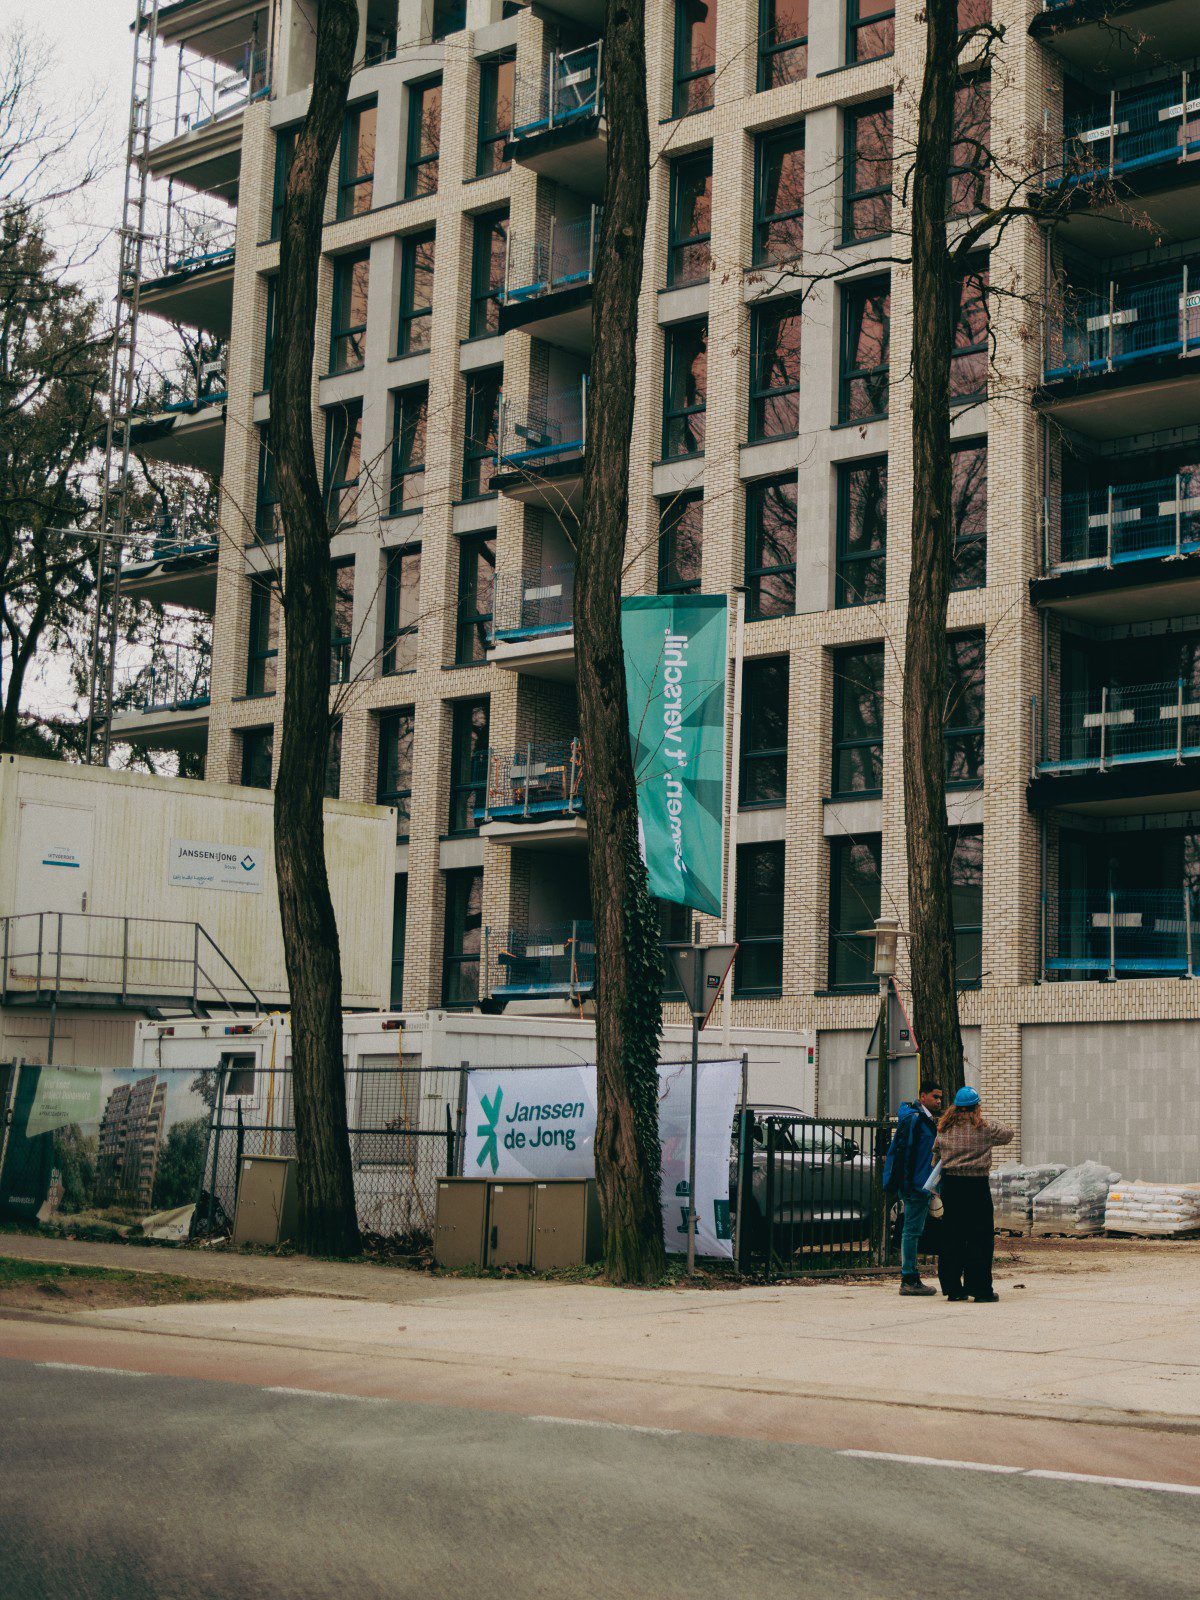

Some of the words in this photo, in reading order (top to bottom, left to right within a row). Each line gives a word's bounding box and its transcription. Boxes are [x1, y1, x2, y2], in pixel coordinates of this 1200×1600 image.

[1100, 127, 1119, 136] sae
[506, 1102, 585, 1123] Janssen
[504, 1128, 526, 1150] de
[529, 1126, 576, 1151] Jong
